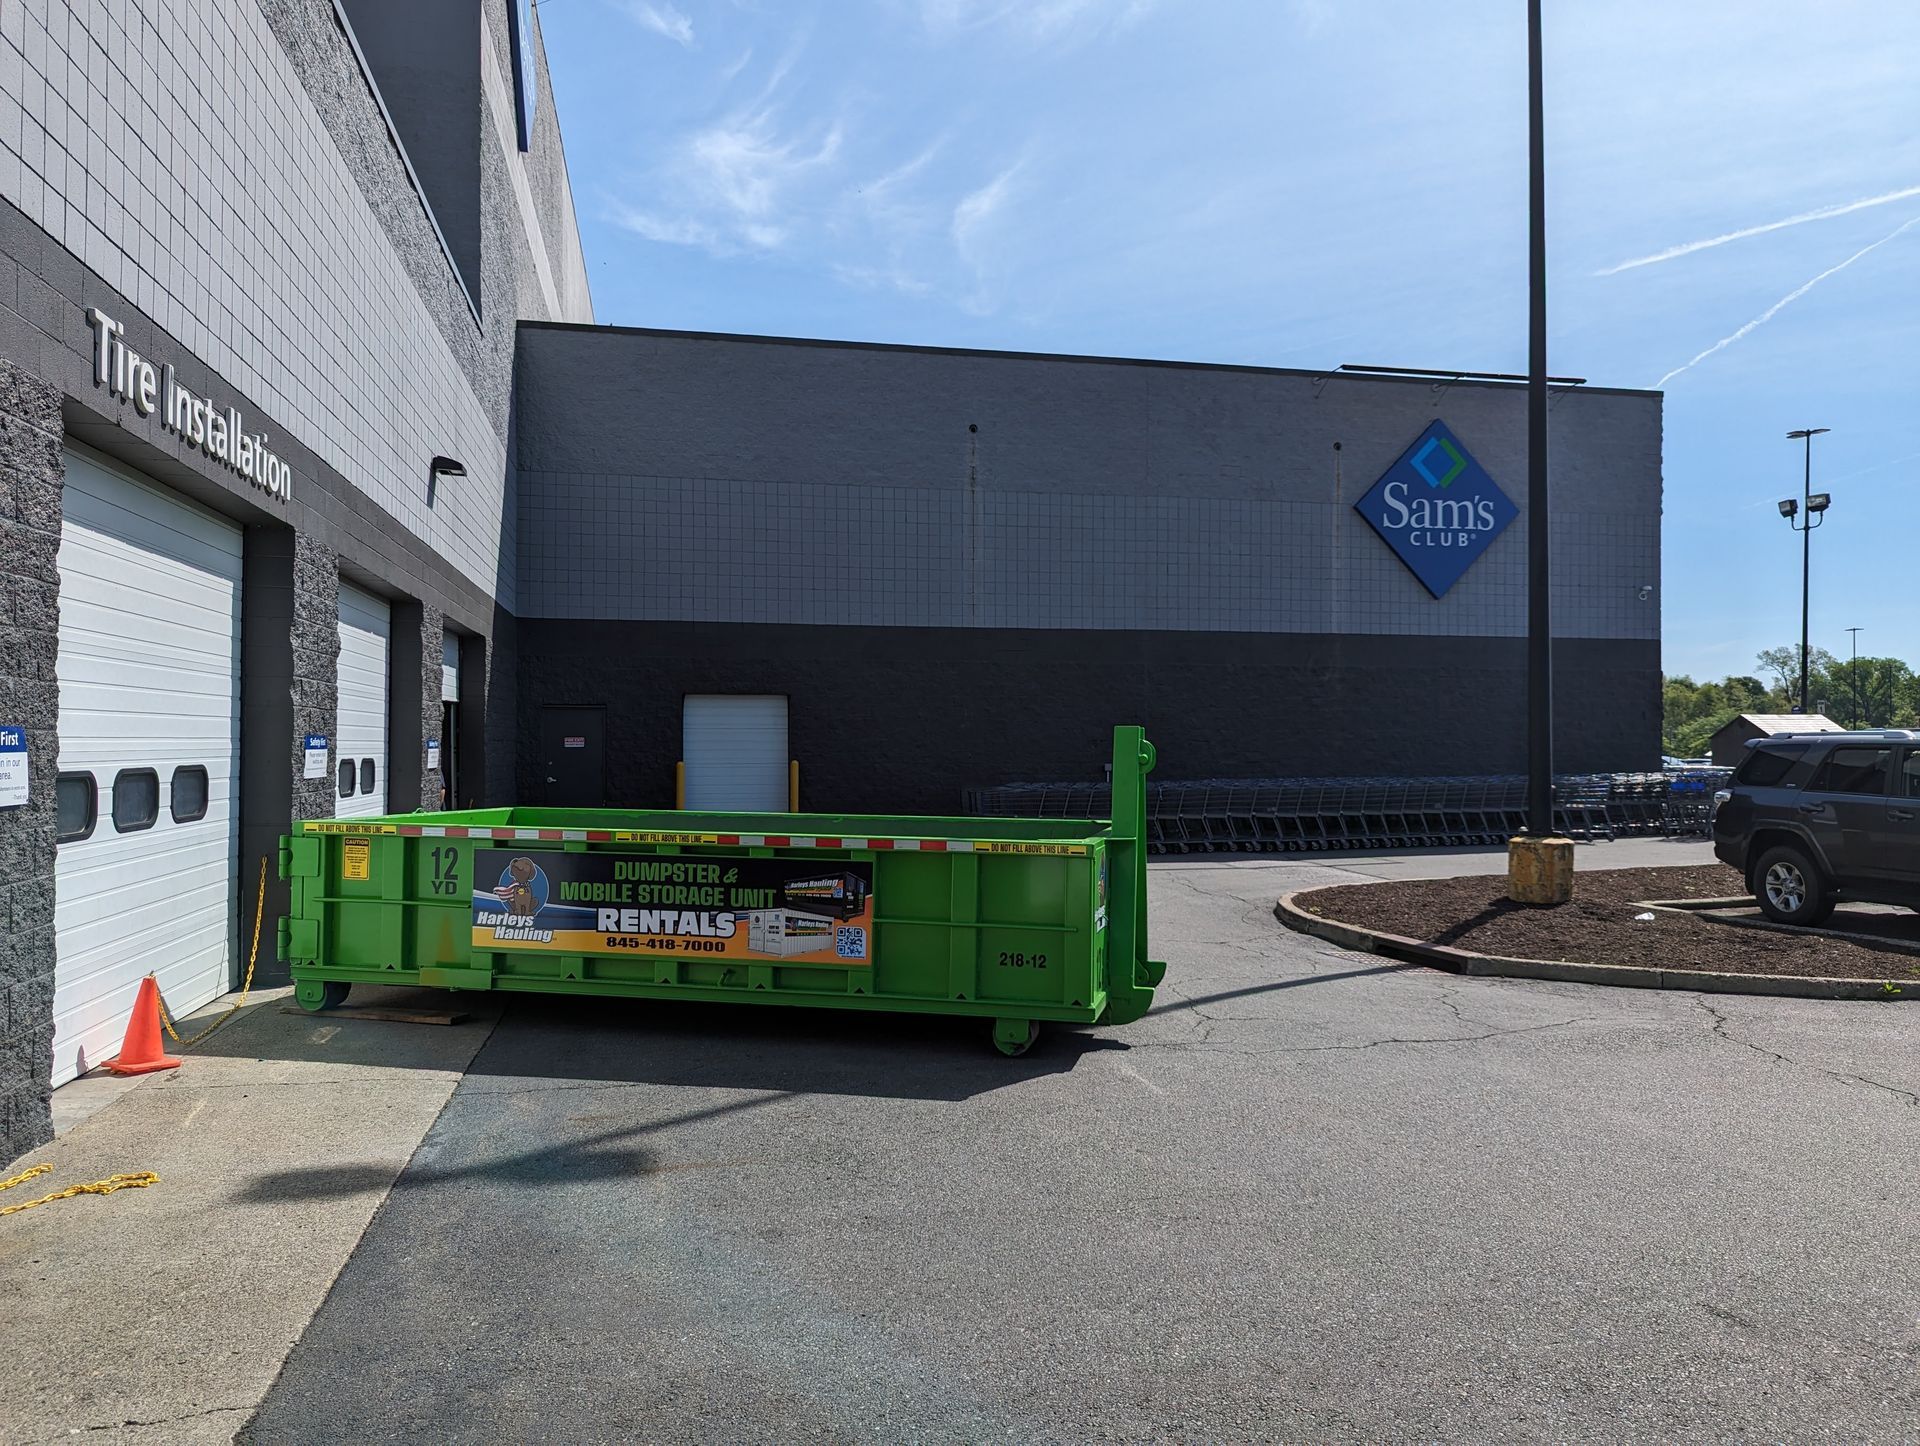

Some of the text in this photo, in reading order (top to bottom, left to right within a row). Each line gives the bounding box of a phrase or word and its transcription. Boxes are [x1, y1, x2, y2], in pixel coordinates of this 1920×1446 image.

[87, 307, 292, 501] Tire Installation
[1383, 481, 1495, 531] Sam's
[0, 731, 19, 746] First
[318, 824, 325, 832] DO
[346, 825, 360, 833] ABOVE
[372, 826, 383, 834] LINE
[631, 833, 702, 843] DO NOT FILL ABOVE THIS LINE
[991, 843, 1069, 854] DO NOT FILL ABOVE THIS LINE
[431, 847, 459, 880] 12
[614, 861, 721, 884] DUMPSTER
[431, 881, 457, 895] YD
[560, 881, 632, 903] MOBILE
[638, 884, 725, 907] STORAGE
[730, 888, 776, 909] UNIT
[477, 911, 535, 927] Harleys
[598, 908, 736, 938] RENTALS
[494, 926, 553, 943] Hauling
[606, 936, 726, 952] 845-418-7000
